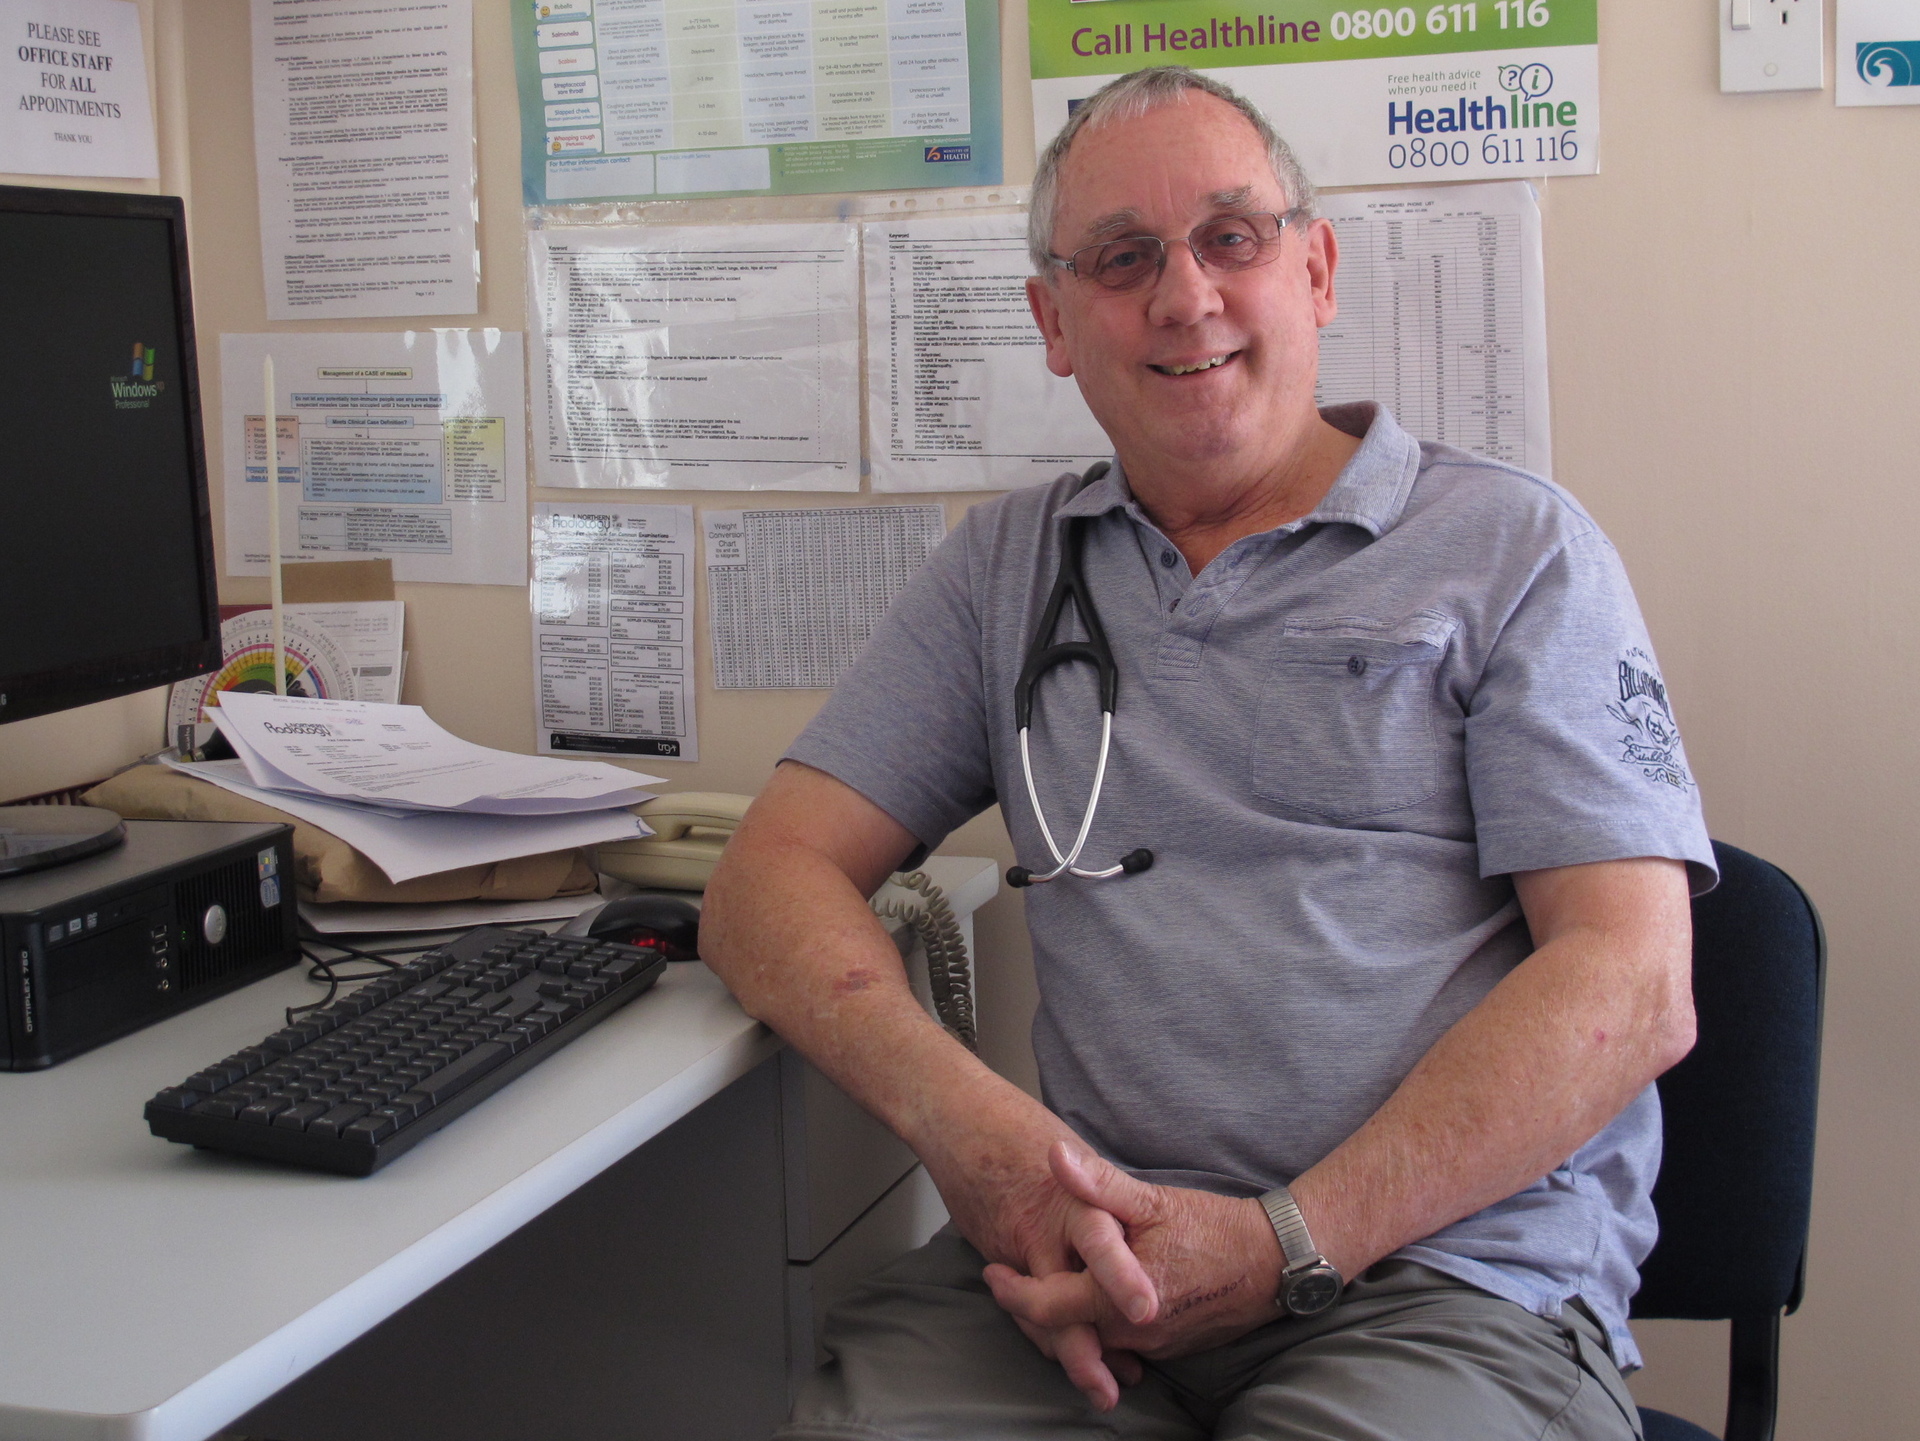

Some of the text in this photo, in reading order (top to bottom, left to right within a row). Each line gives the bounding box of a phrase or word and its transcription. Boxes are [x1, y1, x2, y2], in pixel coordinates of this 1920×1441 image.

[27, 22, 101, 47] PLEASE SEE
[552, 30, 579, 38] Salmonella
[1072, 0, 1550, 57] Call Healthline 0800 611 116
[18, 46, 113, 72] OFFICE STAFF
[41, 72, 96, 93] FOR ALL
[1388, 69, 1481, 84] Free health advice
[554, 81, 586, 89] Streptococcal
[1388, 81, 1477, 96] when you need it
[19, 95, 121, 119] APPOINTMENTS
[554, 109, 574, 117] Slapped
[1388, 94, 1578, 136] Healthline
[54, 132, 92, 144] THANK YOU
[554, 133, 595, 143] Whooping cough
[1388, 129, 1578, 169] 0800 611 116
[112, 382, 157, 398] Windows
[115, 400, 150, 409] Professional
[714, 522, 737, 531] Weight
[264, 721, 331, 737] Radiology
[23, 978, 33, 1032] OPTIPLEX
